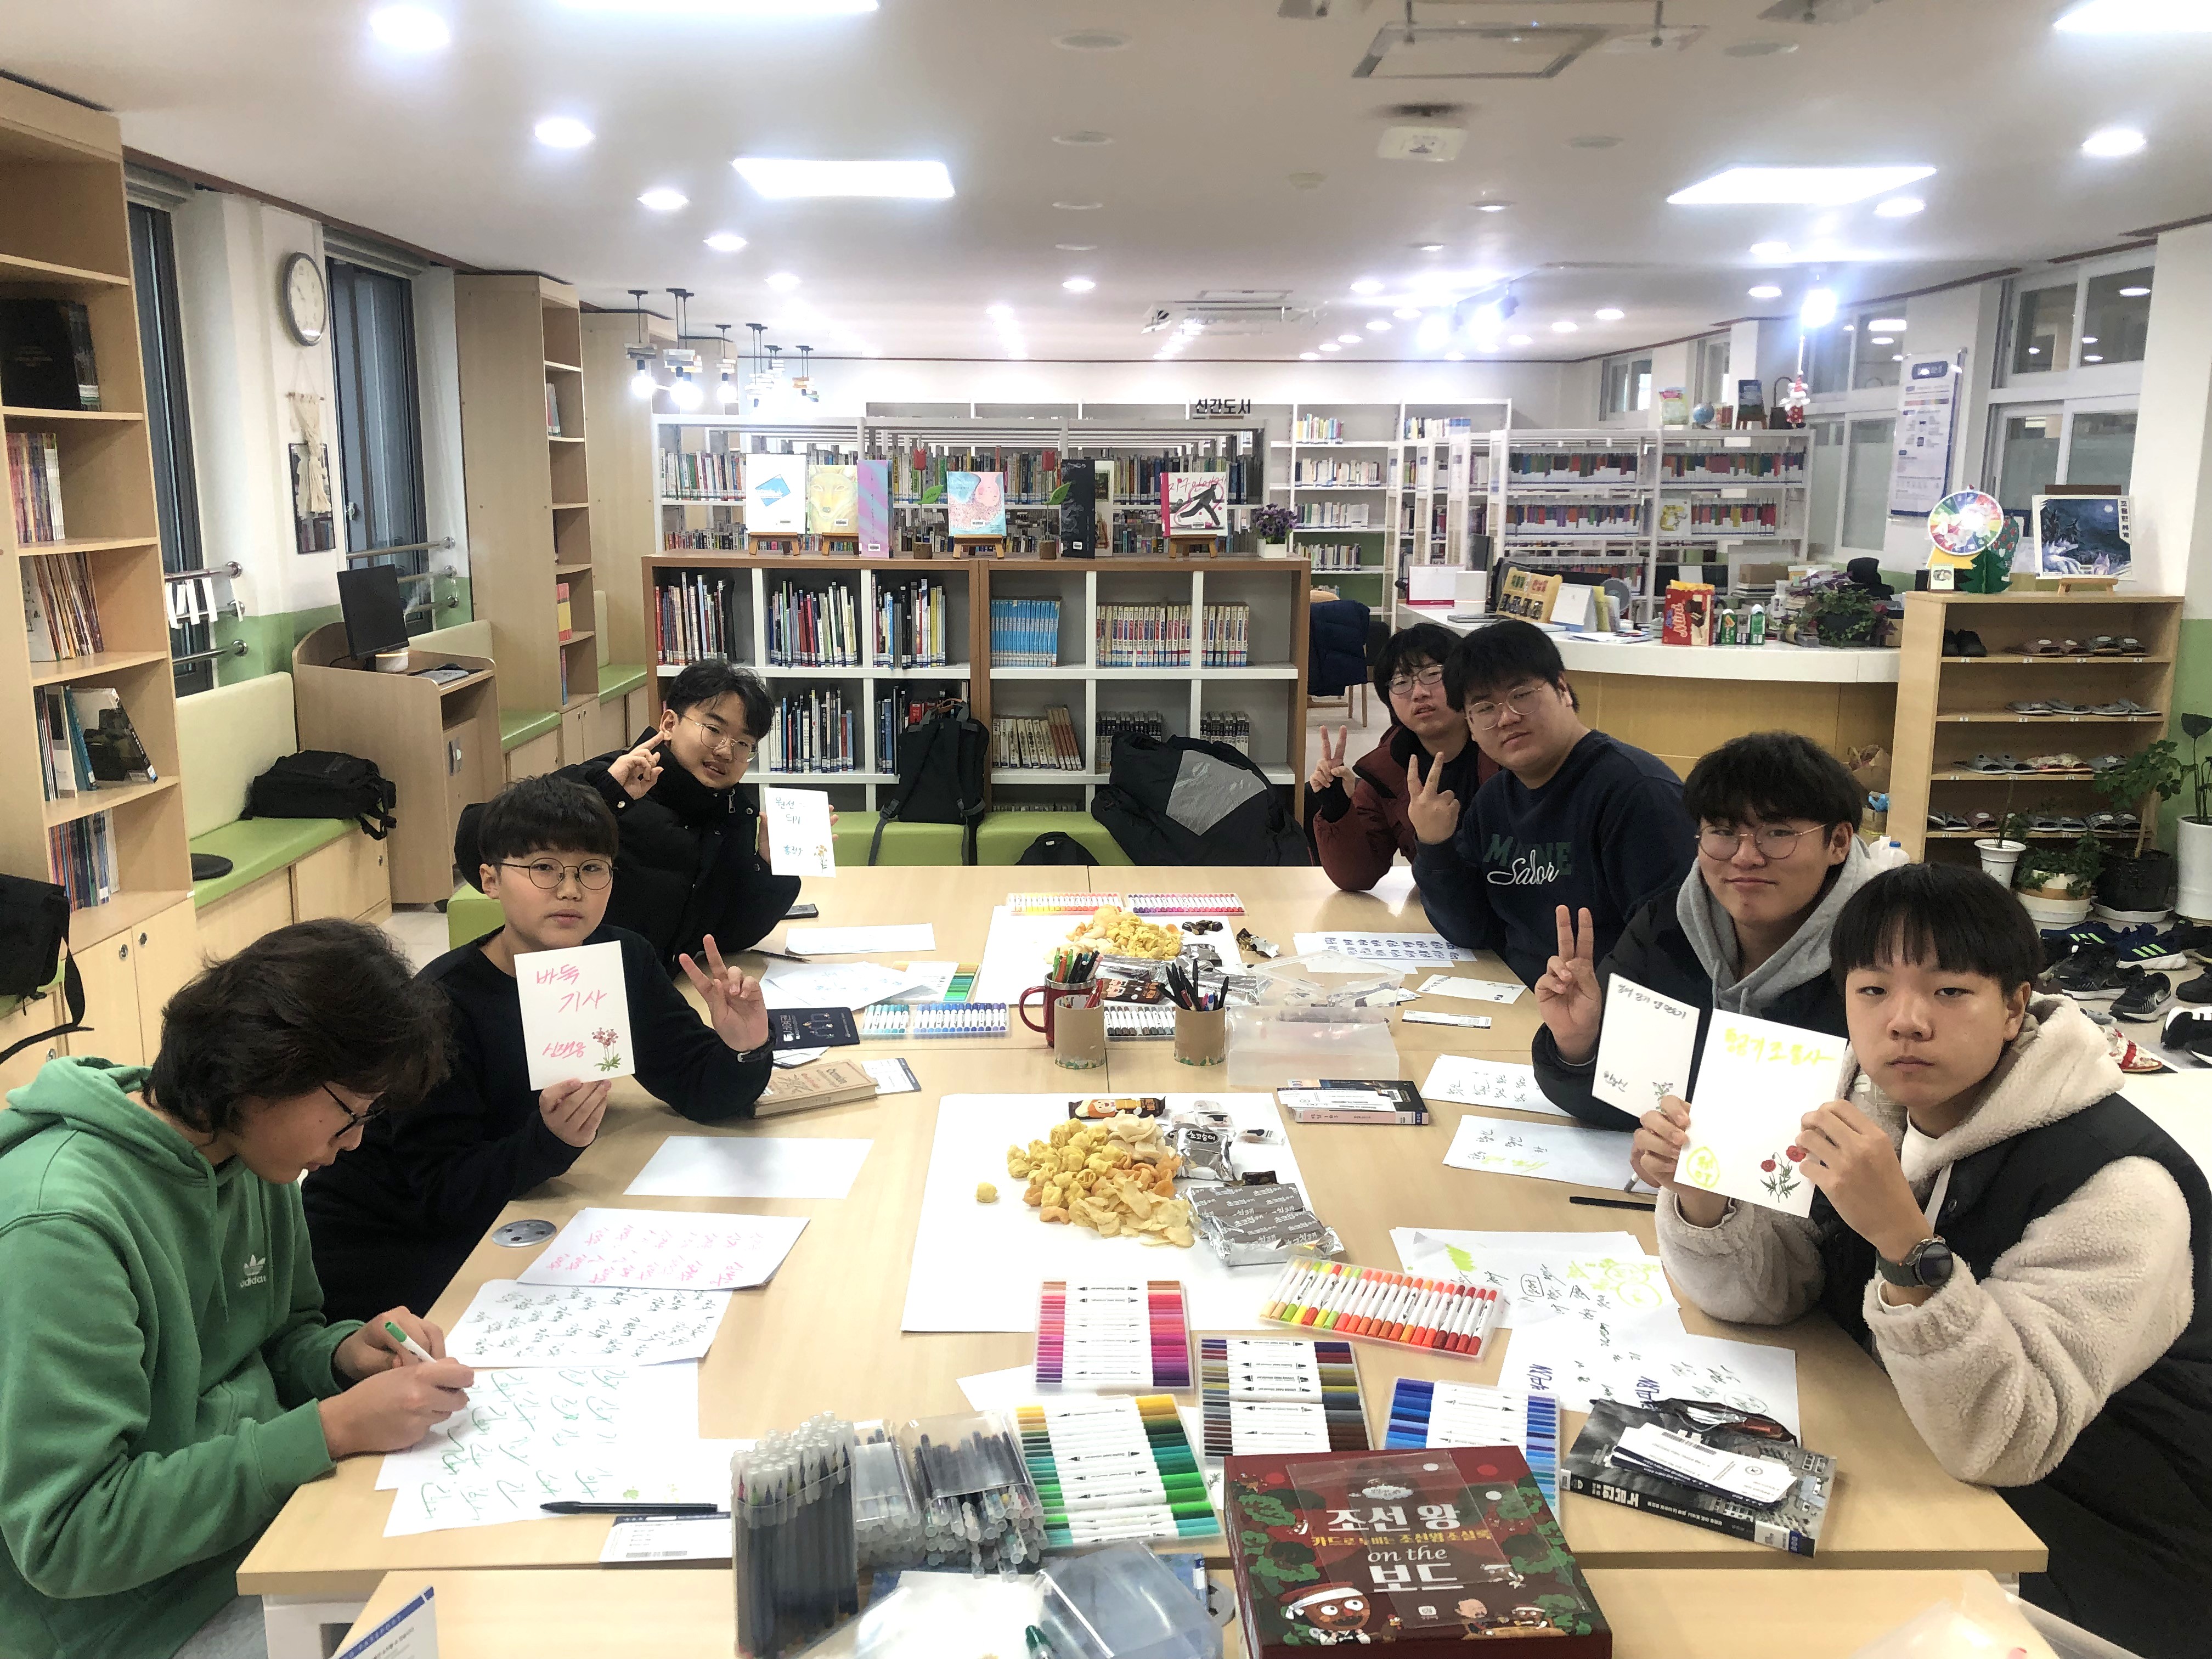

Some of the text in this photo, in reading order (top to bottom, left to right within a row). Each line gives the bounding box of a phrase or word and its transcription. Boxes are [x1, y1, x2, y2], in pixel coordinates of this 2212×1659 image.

[1195, 398, 1251, 414] 신간도서
[558, 989, 607, 1013] 기사
[1187, 1131, 1216, 1142] 초코송이
[1368, 1545, 1448, 1563] on the
[1369, 1563, 1464, 1592] 보드
